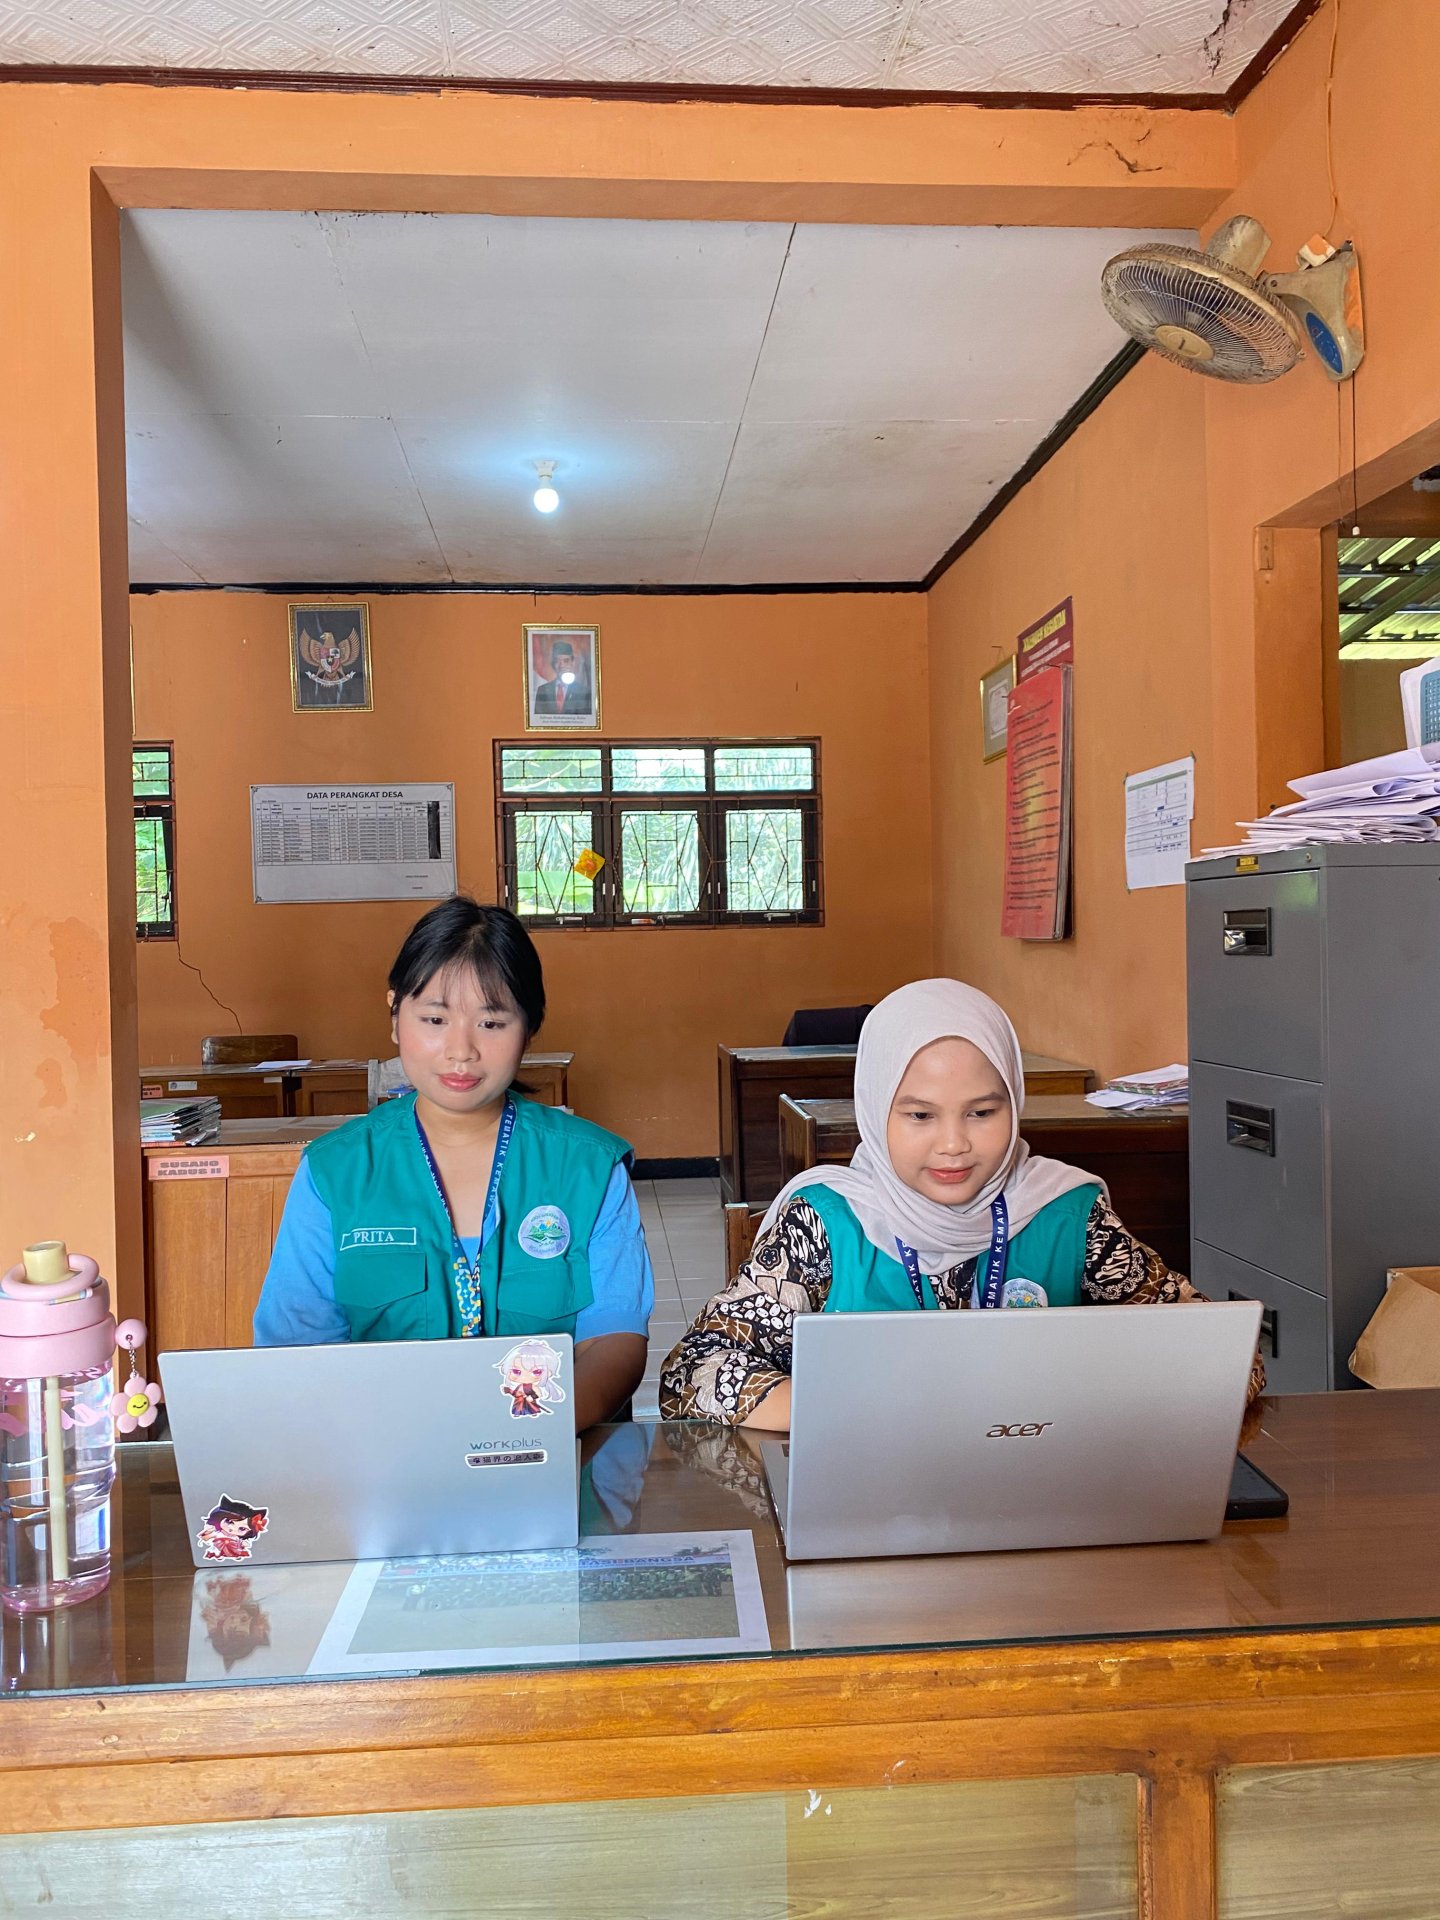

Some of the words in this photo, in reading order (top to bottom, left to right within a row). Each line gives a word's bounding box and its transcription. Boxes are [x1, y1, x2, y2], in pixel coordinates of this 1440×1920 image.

[330, 791, 380, 799] PERANGKAT
[499, 1113, 513, 1157] TEMATIK
[353, 1230, 395, 1243] PRITA
[986, 1259, 1001, 1309] EMATIK
[994, 1201, 1006, 1253] KEMAWI
[986, 1422, 1054, 1438] acer
[469, 1437, 543, 1450] workplus
